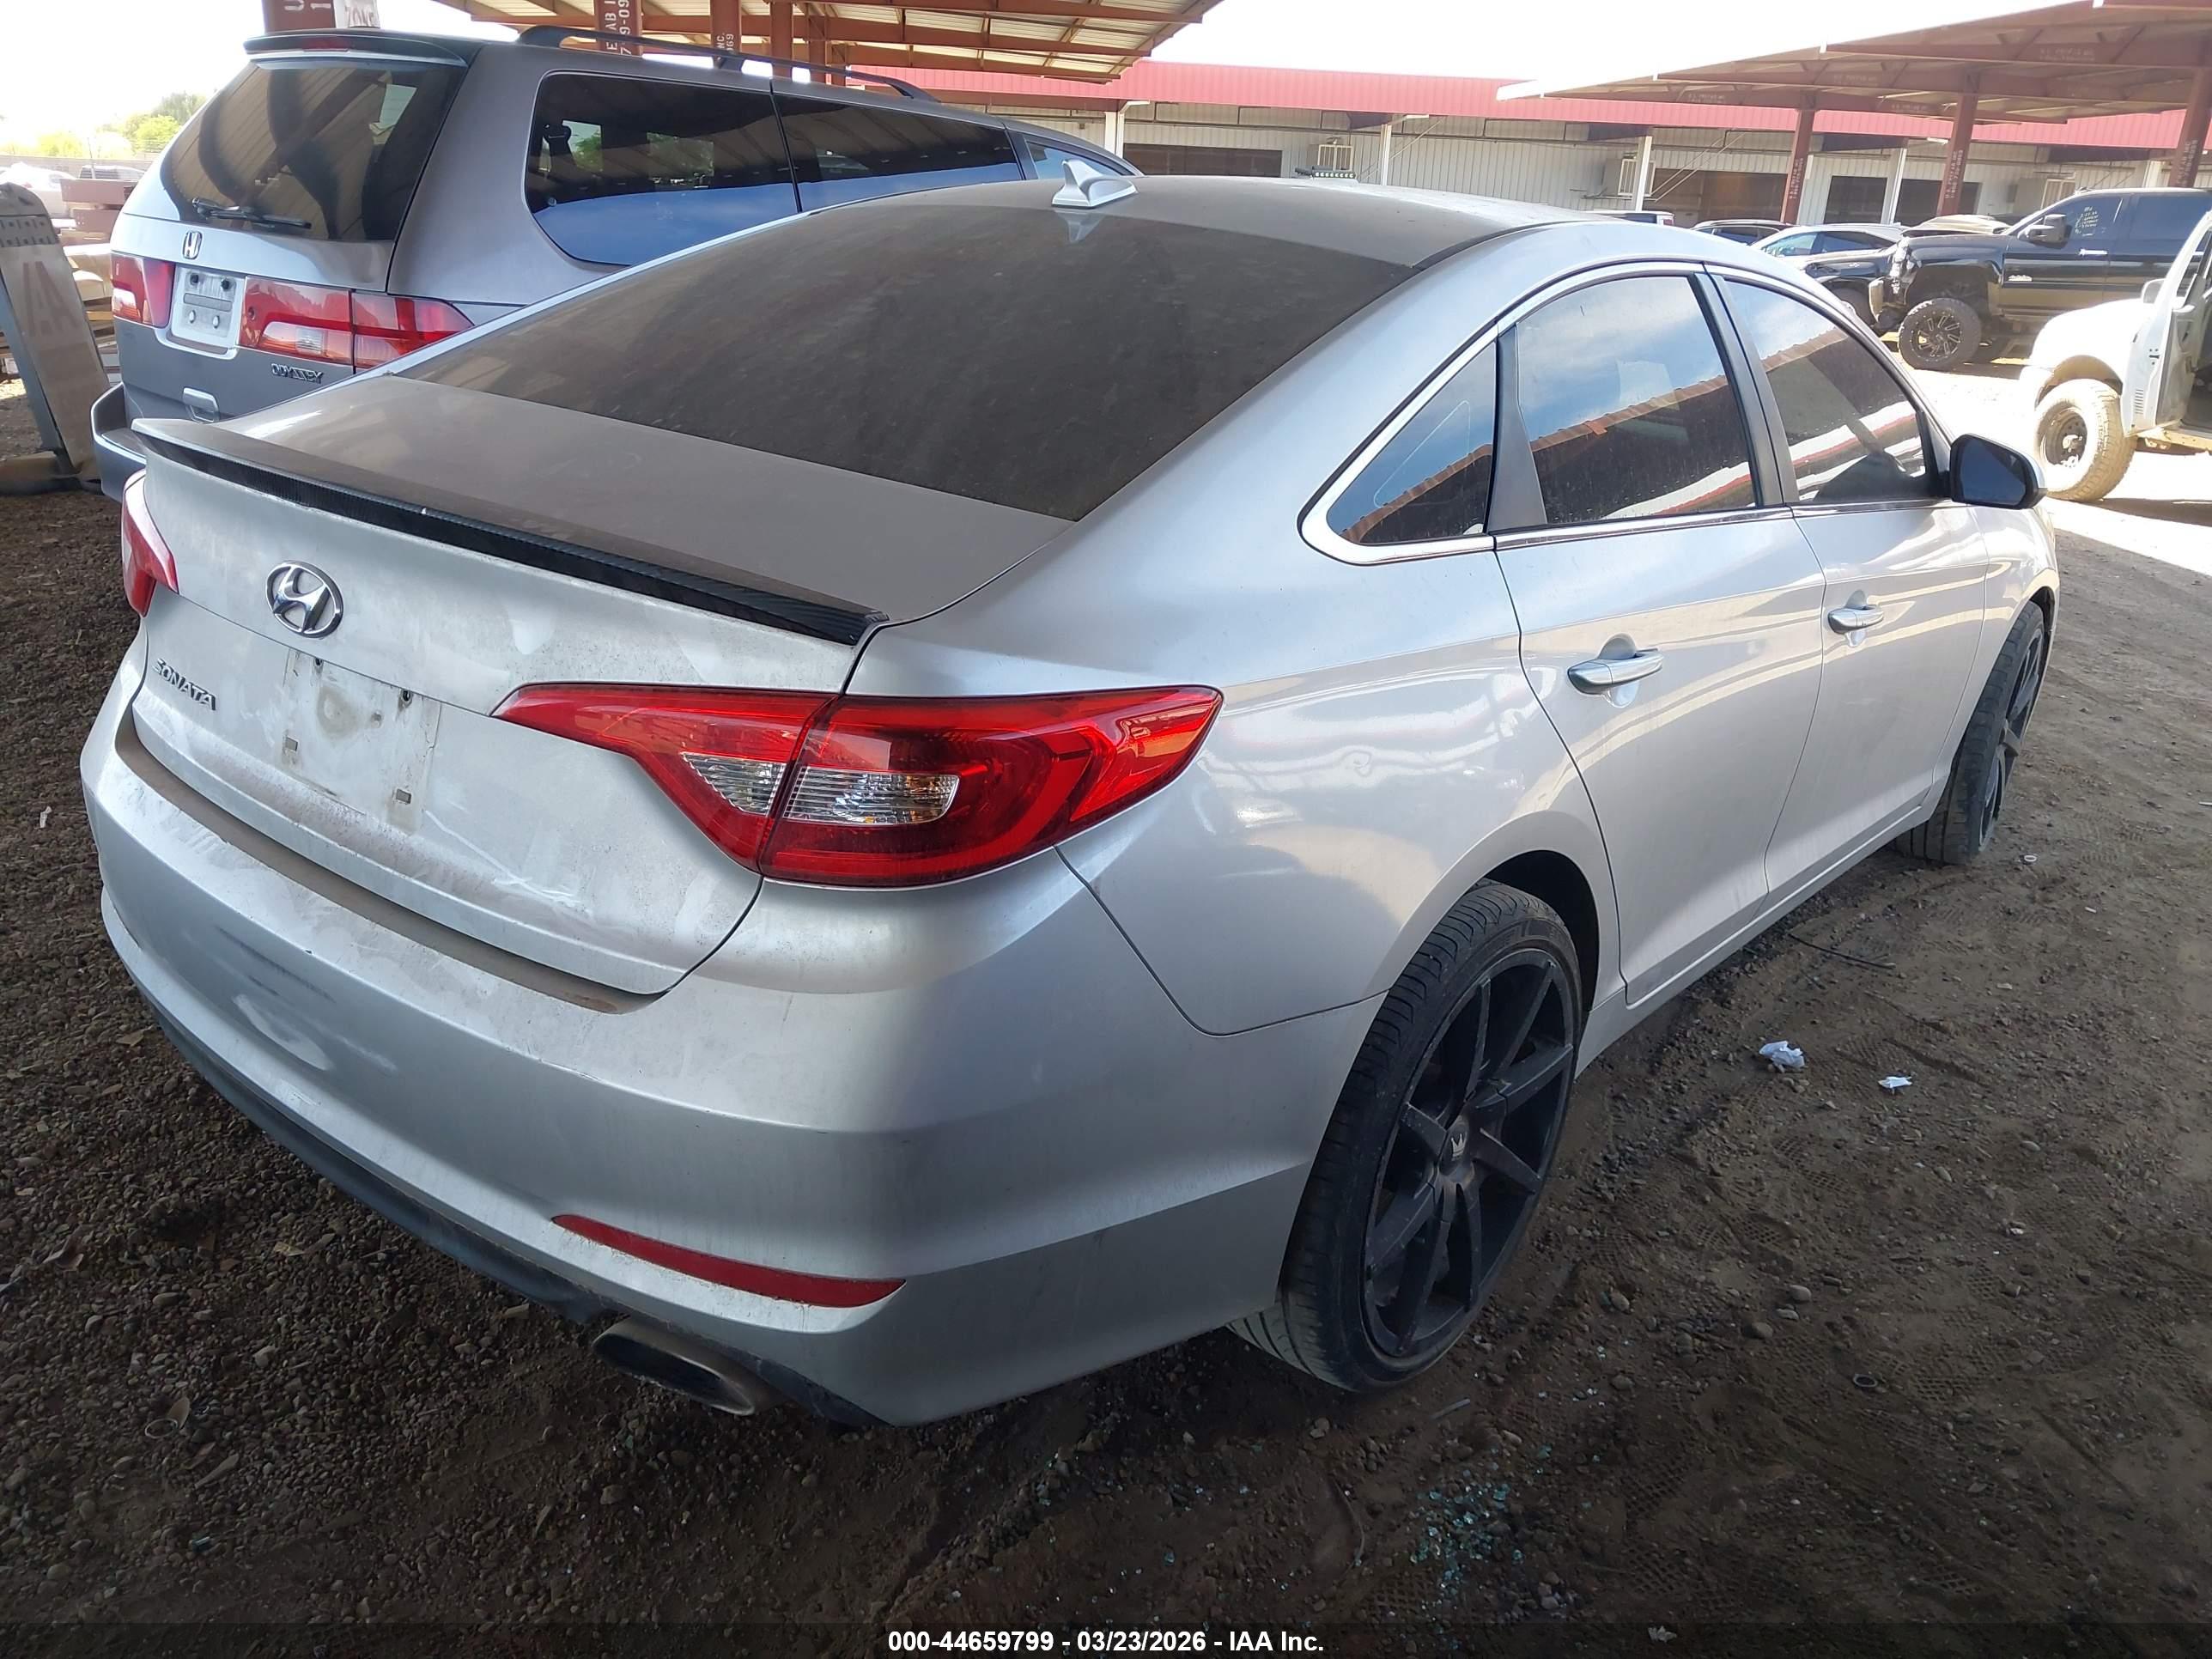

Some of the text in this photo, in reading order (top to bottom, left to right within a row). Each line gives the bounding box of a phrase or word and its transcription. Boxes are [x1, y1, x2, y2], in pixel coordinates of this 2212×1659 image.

[605, 13, 618, 51] EAB
[618, 0, 632, 55] 79-09
[270, 362, 325, 384] ODYSSEY
[152, 658, 216, 711] SONATA
